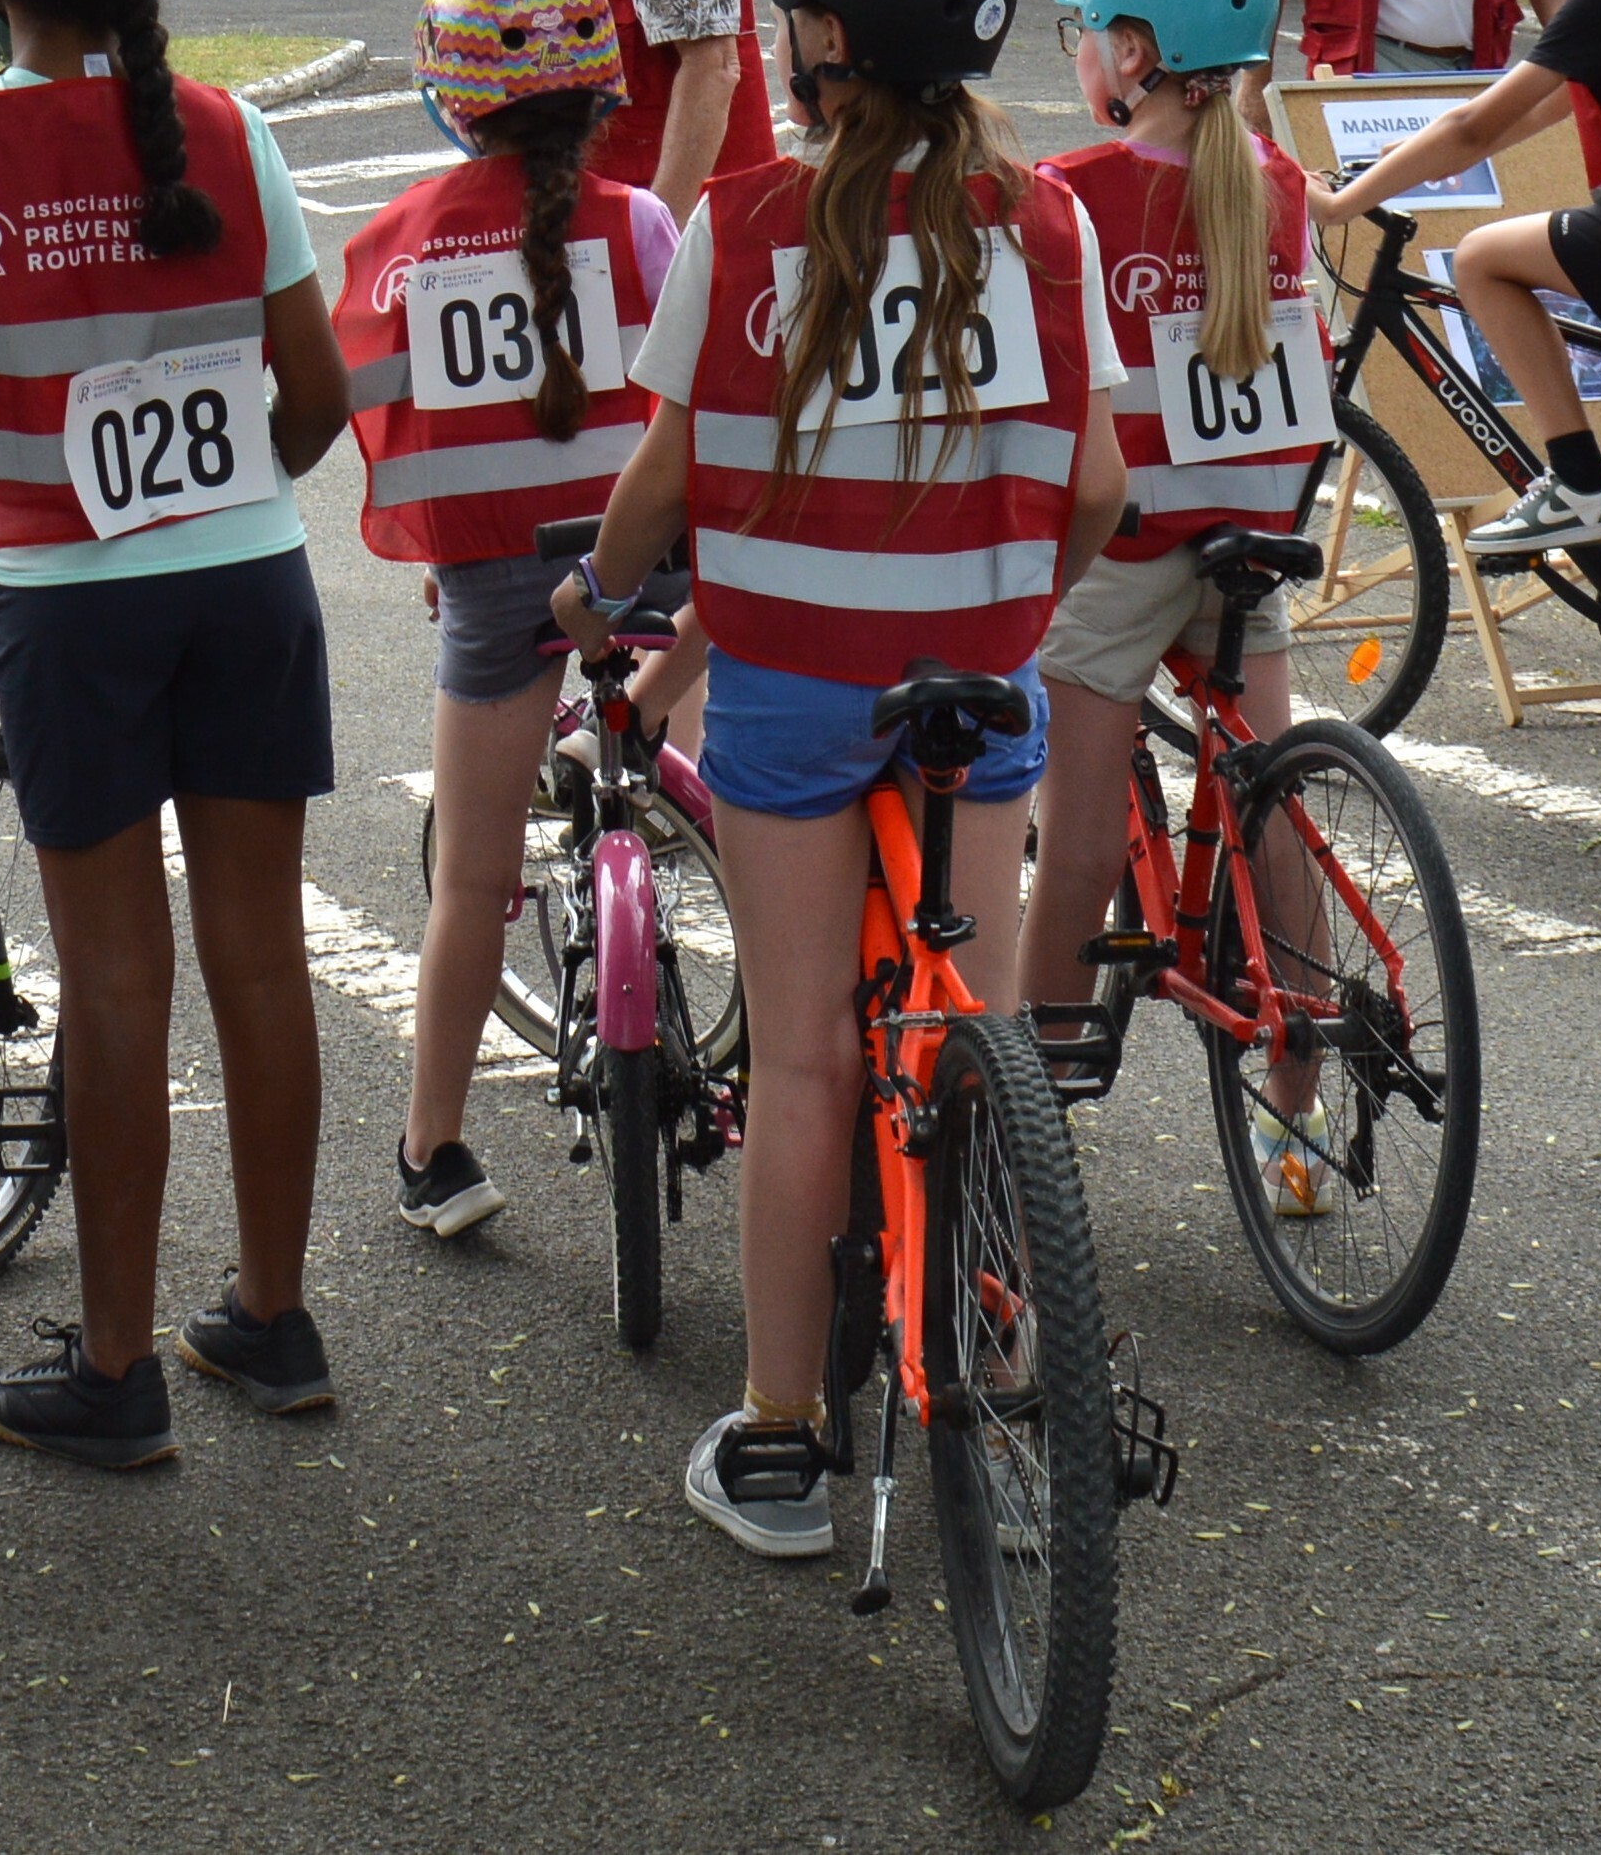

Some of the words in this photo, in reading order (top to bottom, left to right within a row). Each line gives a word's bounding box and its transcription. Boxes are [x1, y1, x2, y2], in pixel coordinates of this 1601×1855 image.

[23, 194, 146, 219] associatio
[183, 348, 240, 363] ASSURANCE
[183, 357, 241, 372] PRÉVENTION
[1188, 342, 1298, 441] 031
[91, 388, 234, 510] 028
